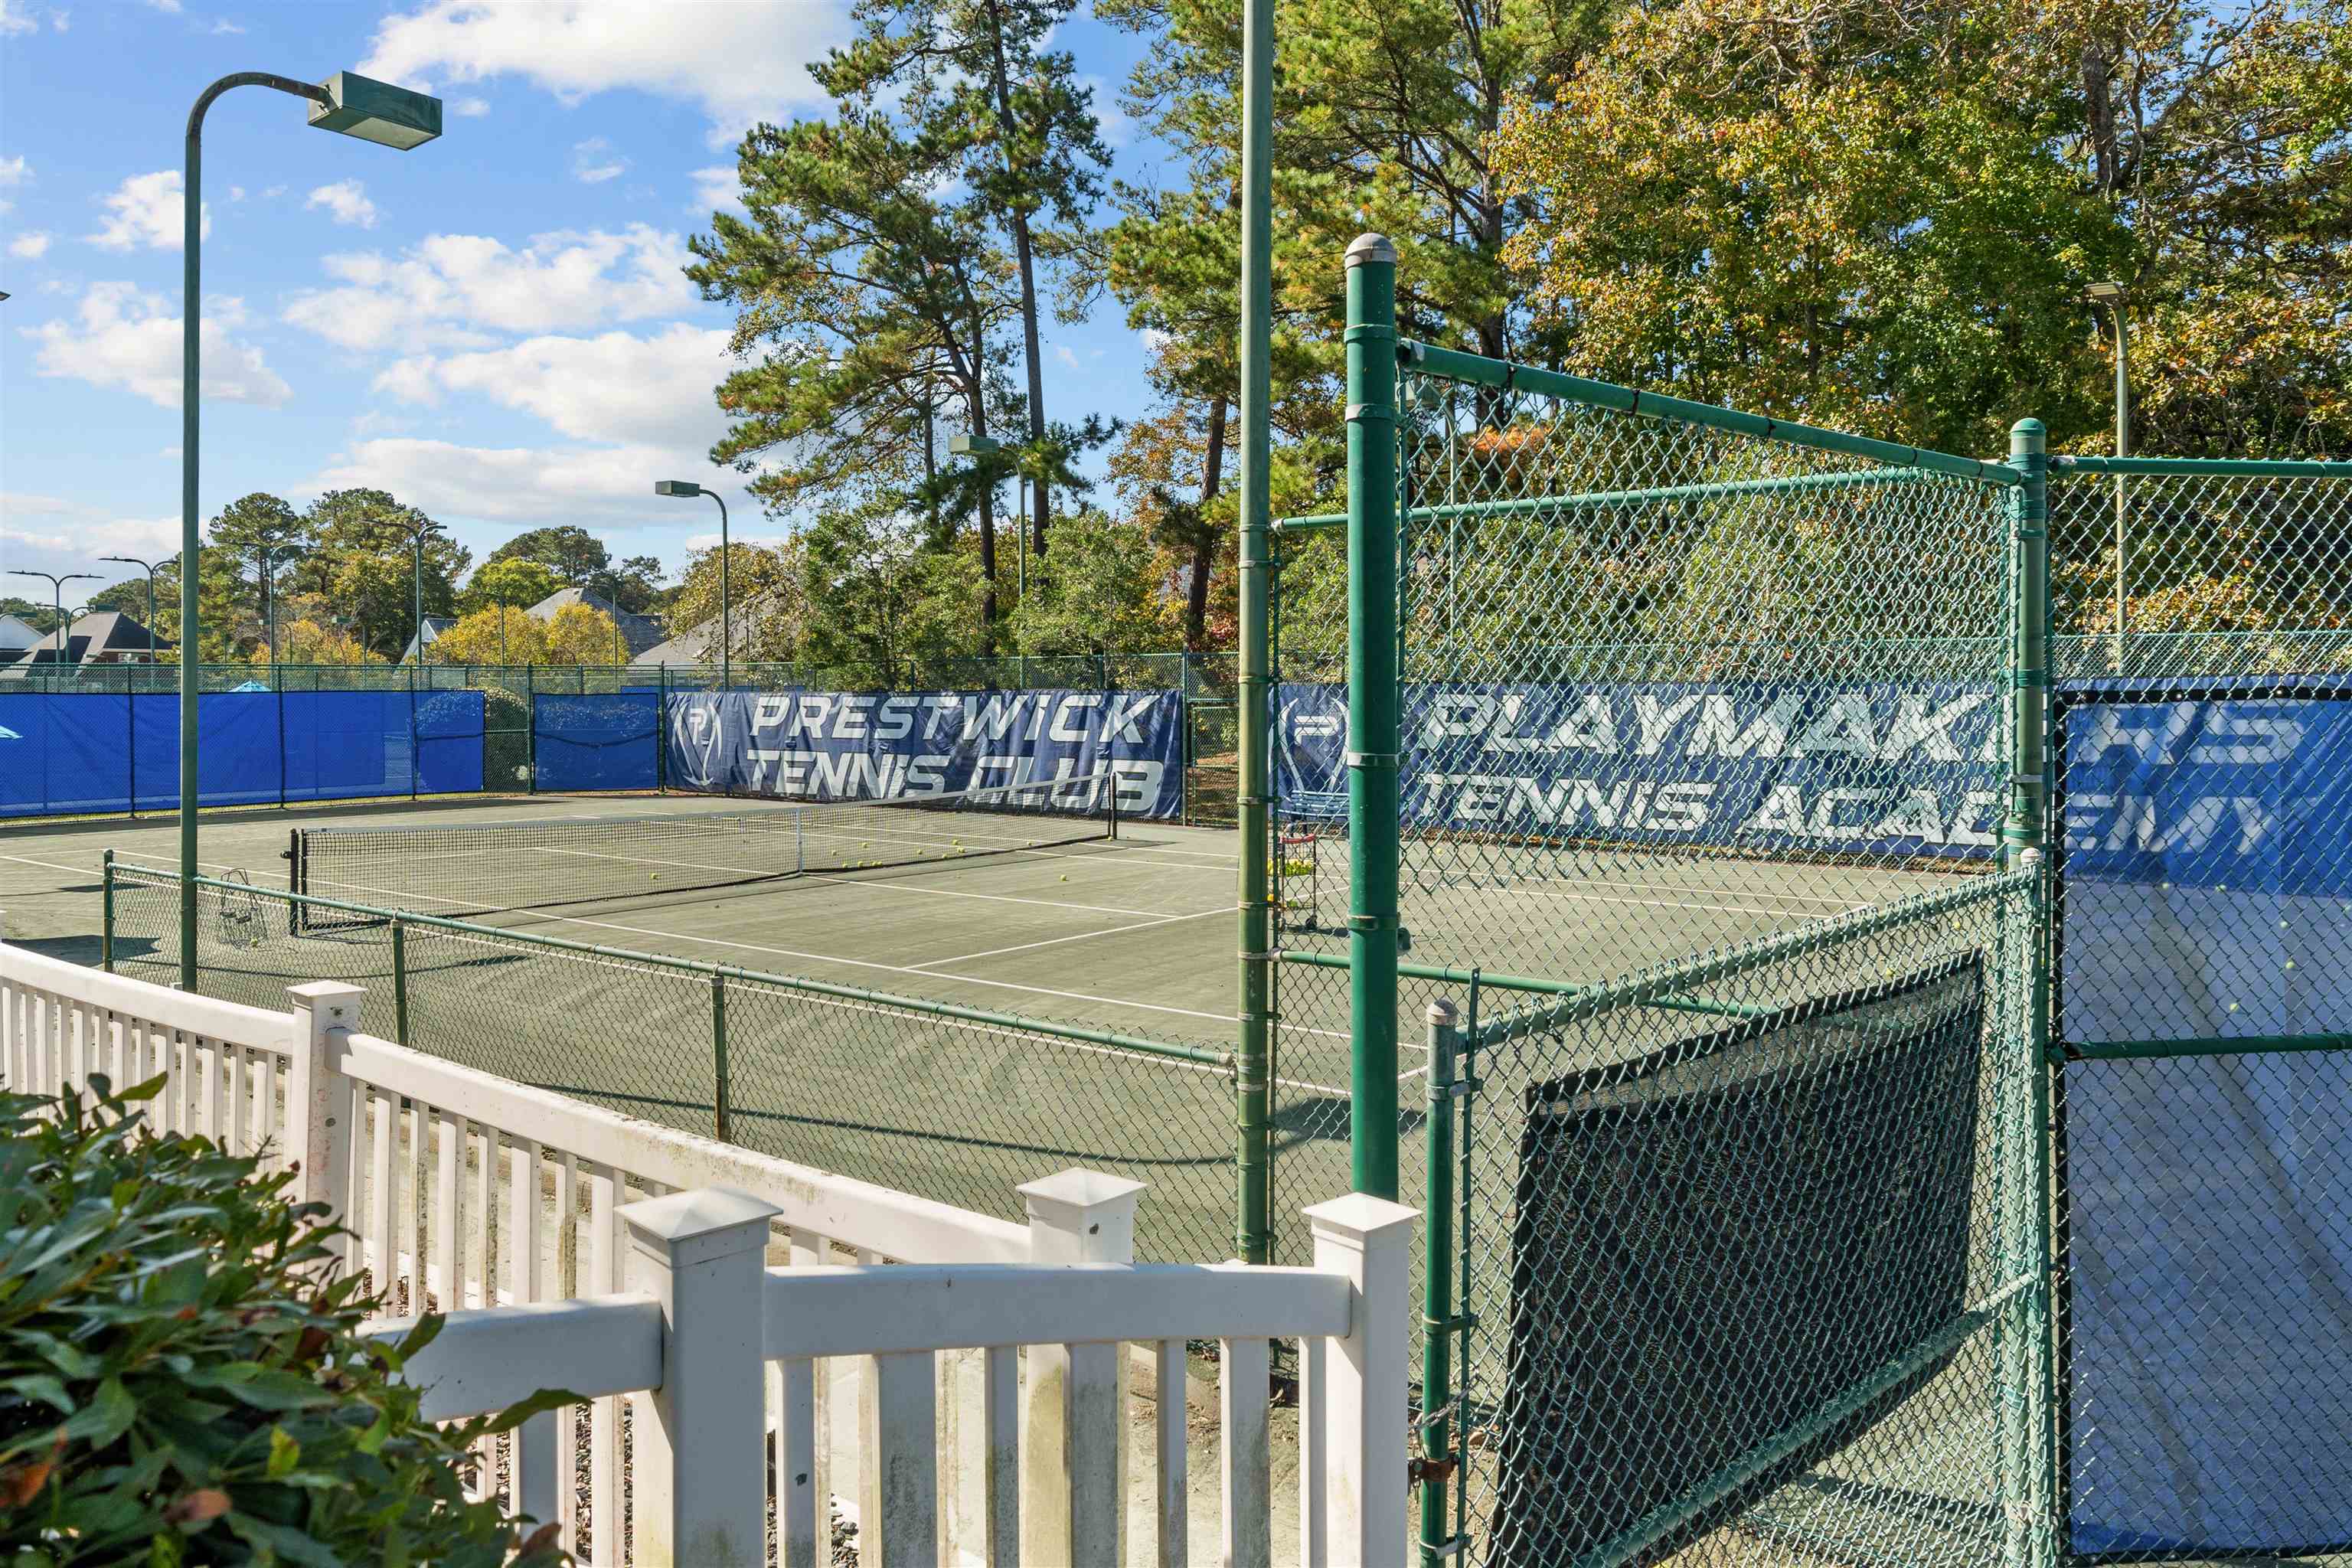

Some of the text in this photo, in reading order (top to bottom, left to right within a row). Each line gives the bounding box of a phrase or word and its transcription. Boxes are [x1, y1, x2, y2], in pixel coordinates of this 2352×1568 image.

[750, 695, 1160, 743] PRESTWICK
[747, 750, 1164, 812] TENNIS CLUB
[1422, 774, 1717, 831] TENNIS
